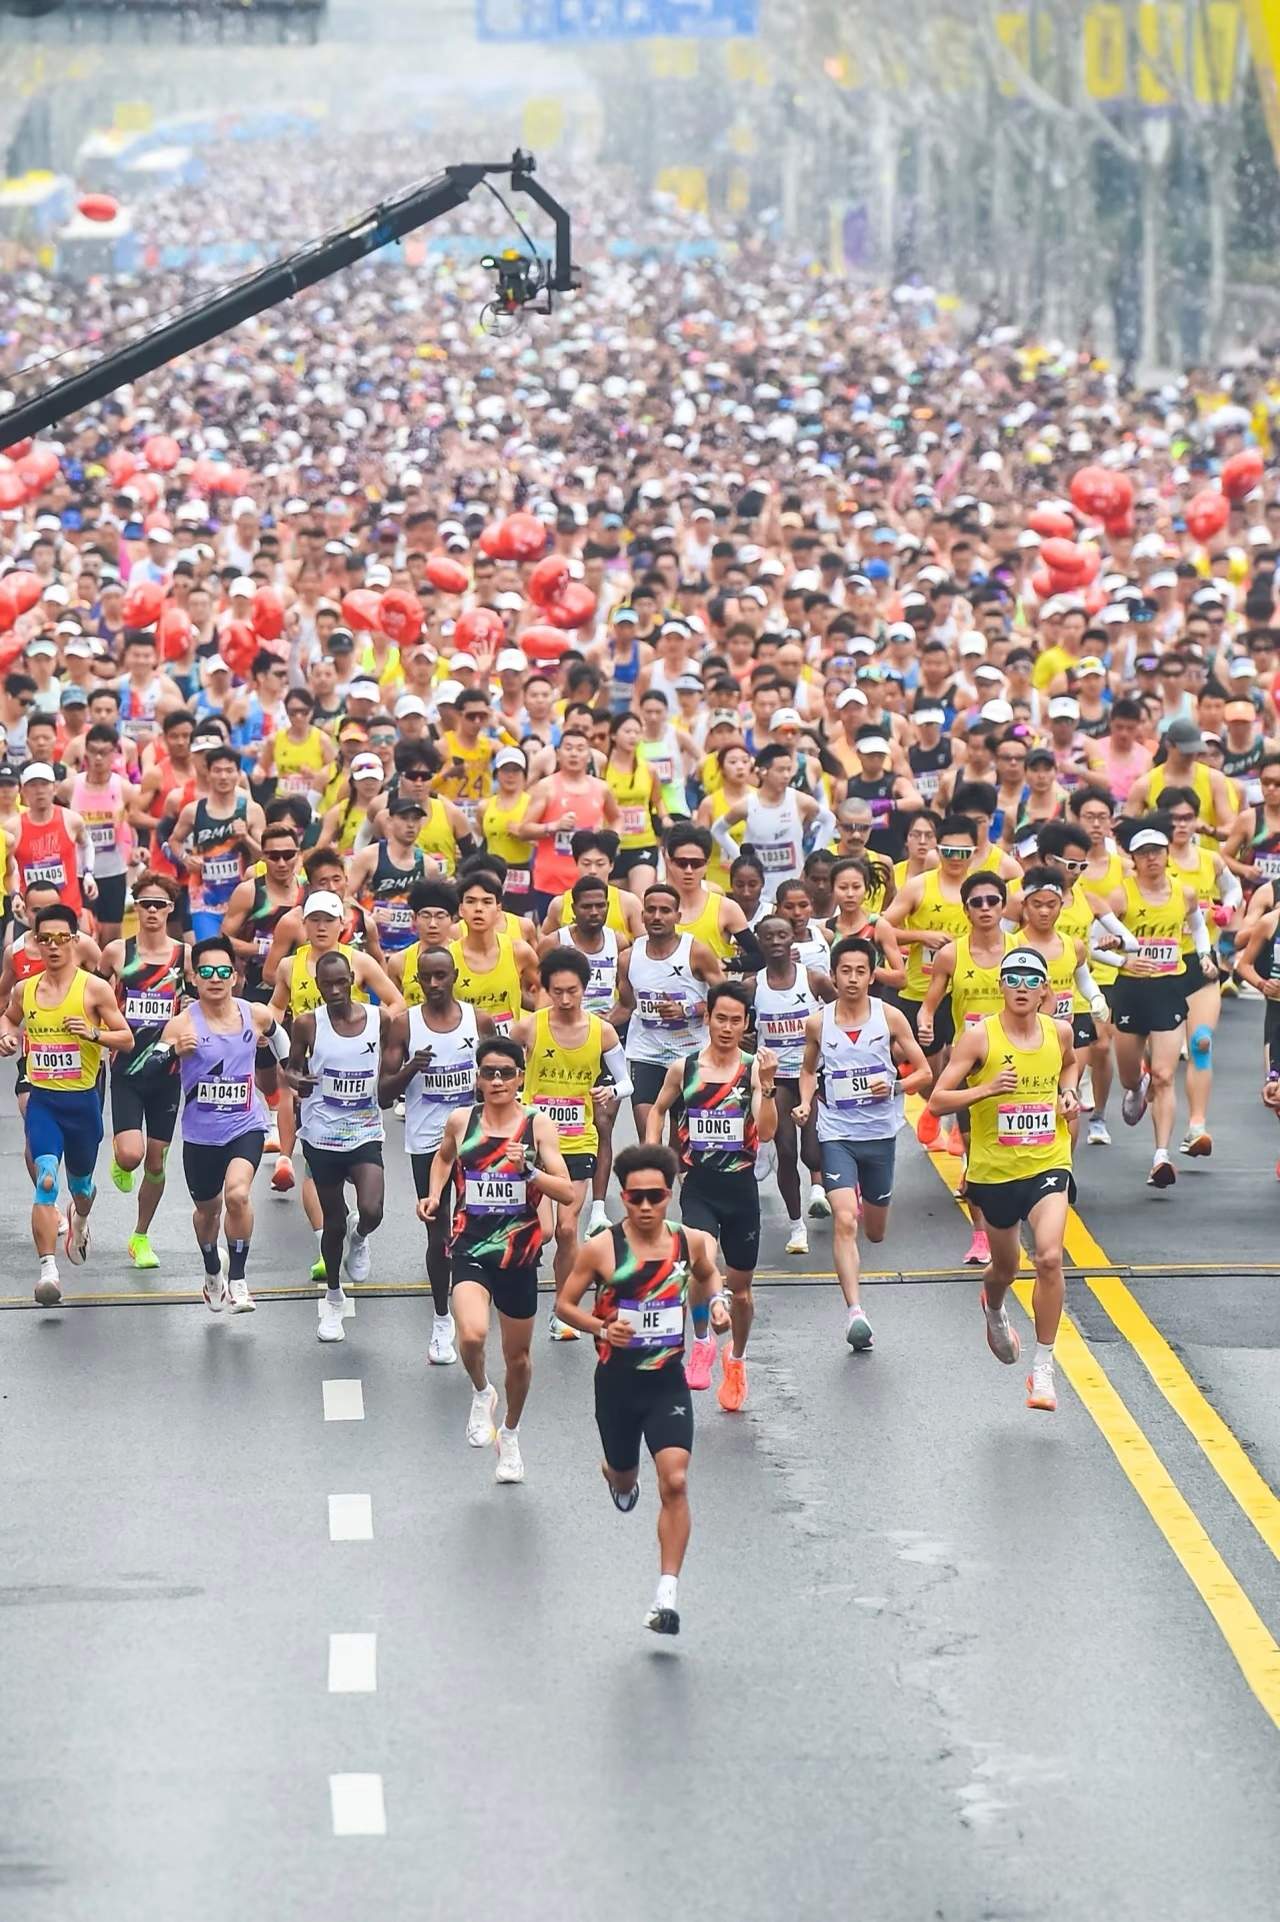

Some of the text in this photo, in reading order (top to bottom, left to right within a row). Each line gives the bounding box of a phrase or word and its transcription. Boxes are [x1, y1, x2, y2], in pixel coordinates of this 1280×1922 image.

[767, 1019, 804, 1034] MAINA
[35, 1053, 73, 1067] Y0013
[333, 1080, 366, 1093] MITEI
[424, 1071, 472, 1088] MUIRURI
[852, 1077, 868, 1092] SU
[697, 1119, 731, 1134] DONG
[1006, 1114, 1049, 1130] Y0014
[477, 1182, 513, 1198] YANG
[643, 1312, 660, 1328] HE
